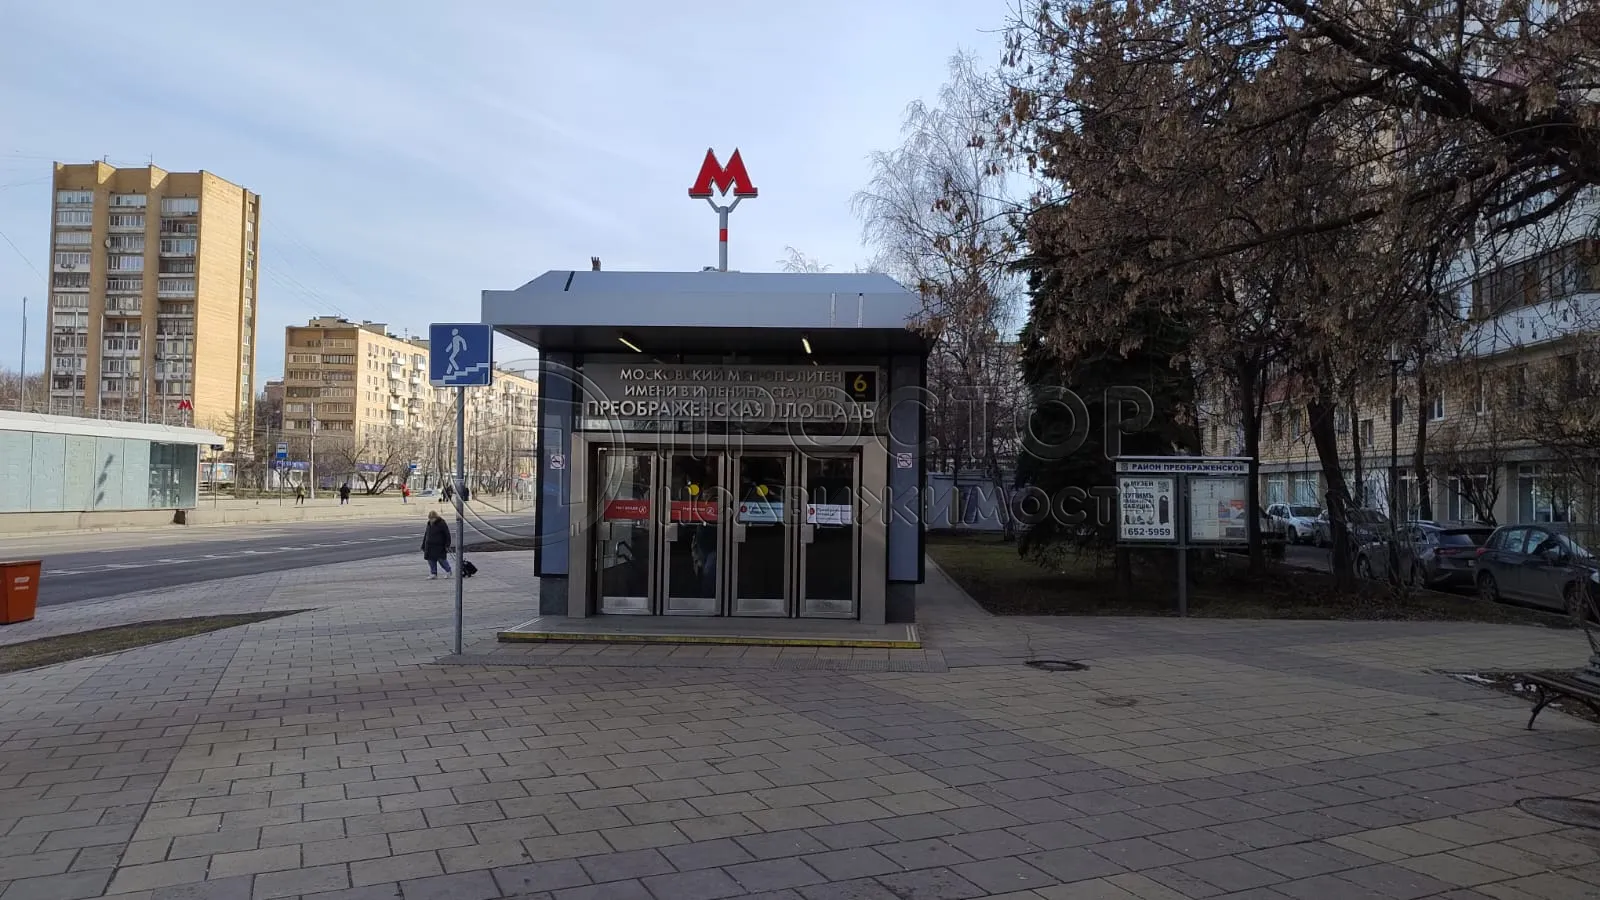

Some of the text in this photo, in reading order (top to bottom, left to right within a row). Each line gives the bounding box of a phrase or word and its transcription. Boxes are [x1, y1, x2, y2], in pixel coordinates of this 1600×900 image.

[688, 146, 759, 197] М
[624, 384, 677, 397] ИМЕНИ
[770, 386, 837, 400] СТАНЦИЯ
[853, 373, 868, 393] 6
[586, 400, 875, 421] ПРЕОБРАЖЕНСКАЯ ПЛОЩАДЬ
[1131, 463, 1161, 471] РАЙОН
